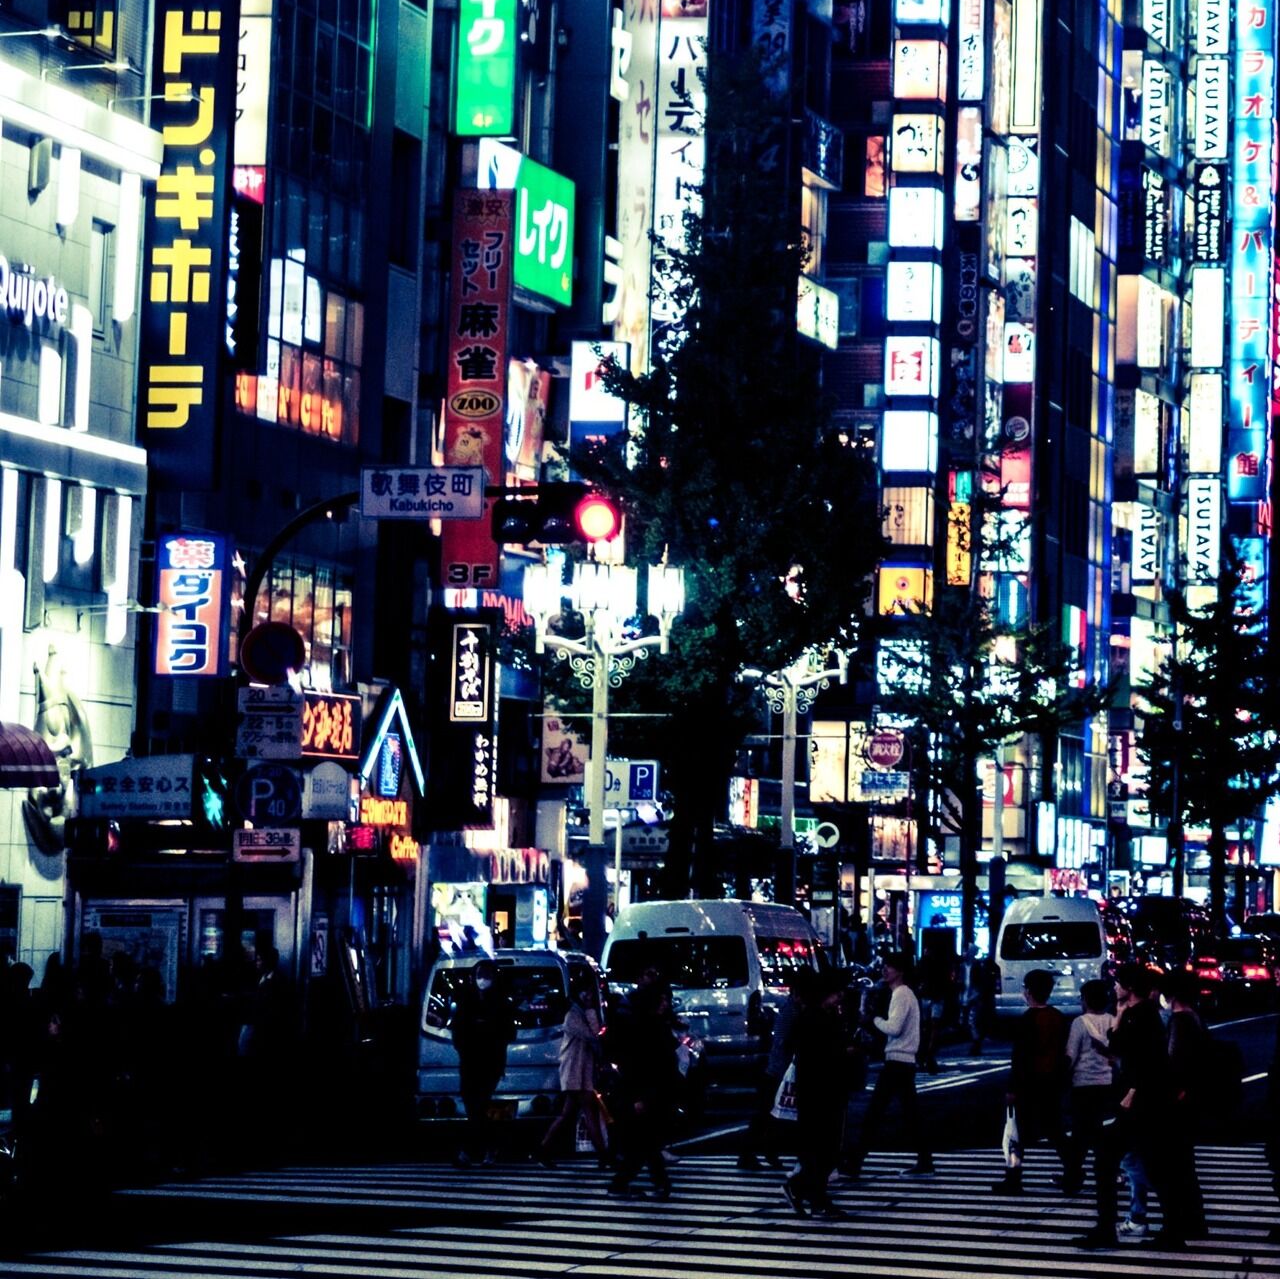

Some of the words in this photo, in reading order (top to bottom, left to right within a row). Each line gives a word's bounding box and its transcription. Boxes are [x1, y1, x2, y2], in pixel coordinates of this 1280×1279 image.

[1203, 65, 1220, 153] TSUTAYA
[518, 186, 570, 260] レイク
[1236, 6, 1267, 478] カラオケ&パーティー館
[459, 238, 479, 298] セット
[484, 231, 503, 290] フリー
[455, 303, 499, 382] 麻雀
[456, 395, 495, 412] ZOO
[369, 470, 475, 499] 歌舞伎町
[389, 499, 454, 513] Kabukicho
[1196, 484, 1212, 582] TSUTAYA
[448, 564, 491, 585] 3F
[169, 572, 215, 675] ダイコク
[250, 777, 276, 817] P
[636, 767, 649, 784] P
